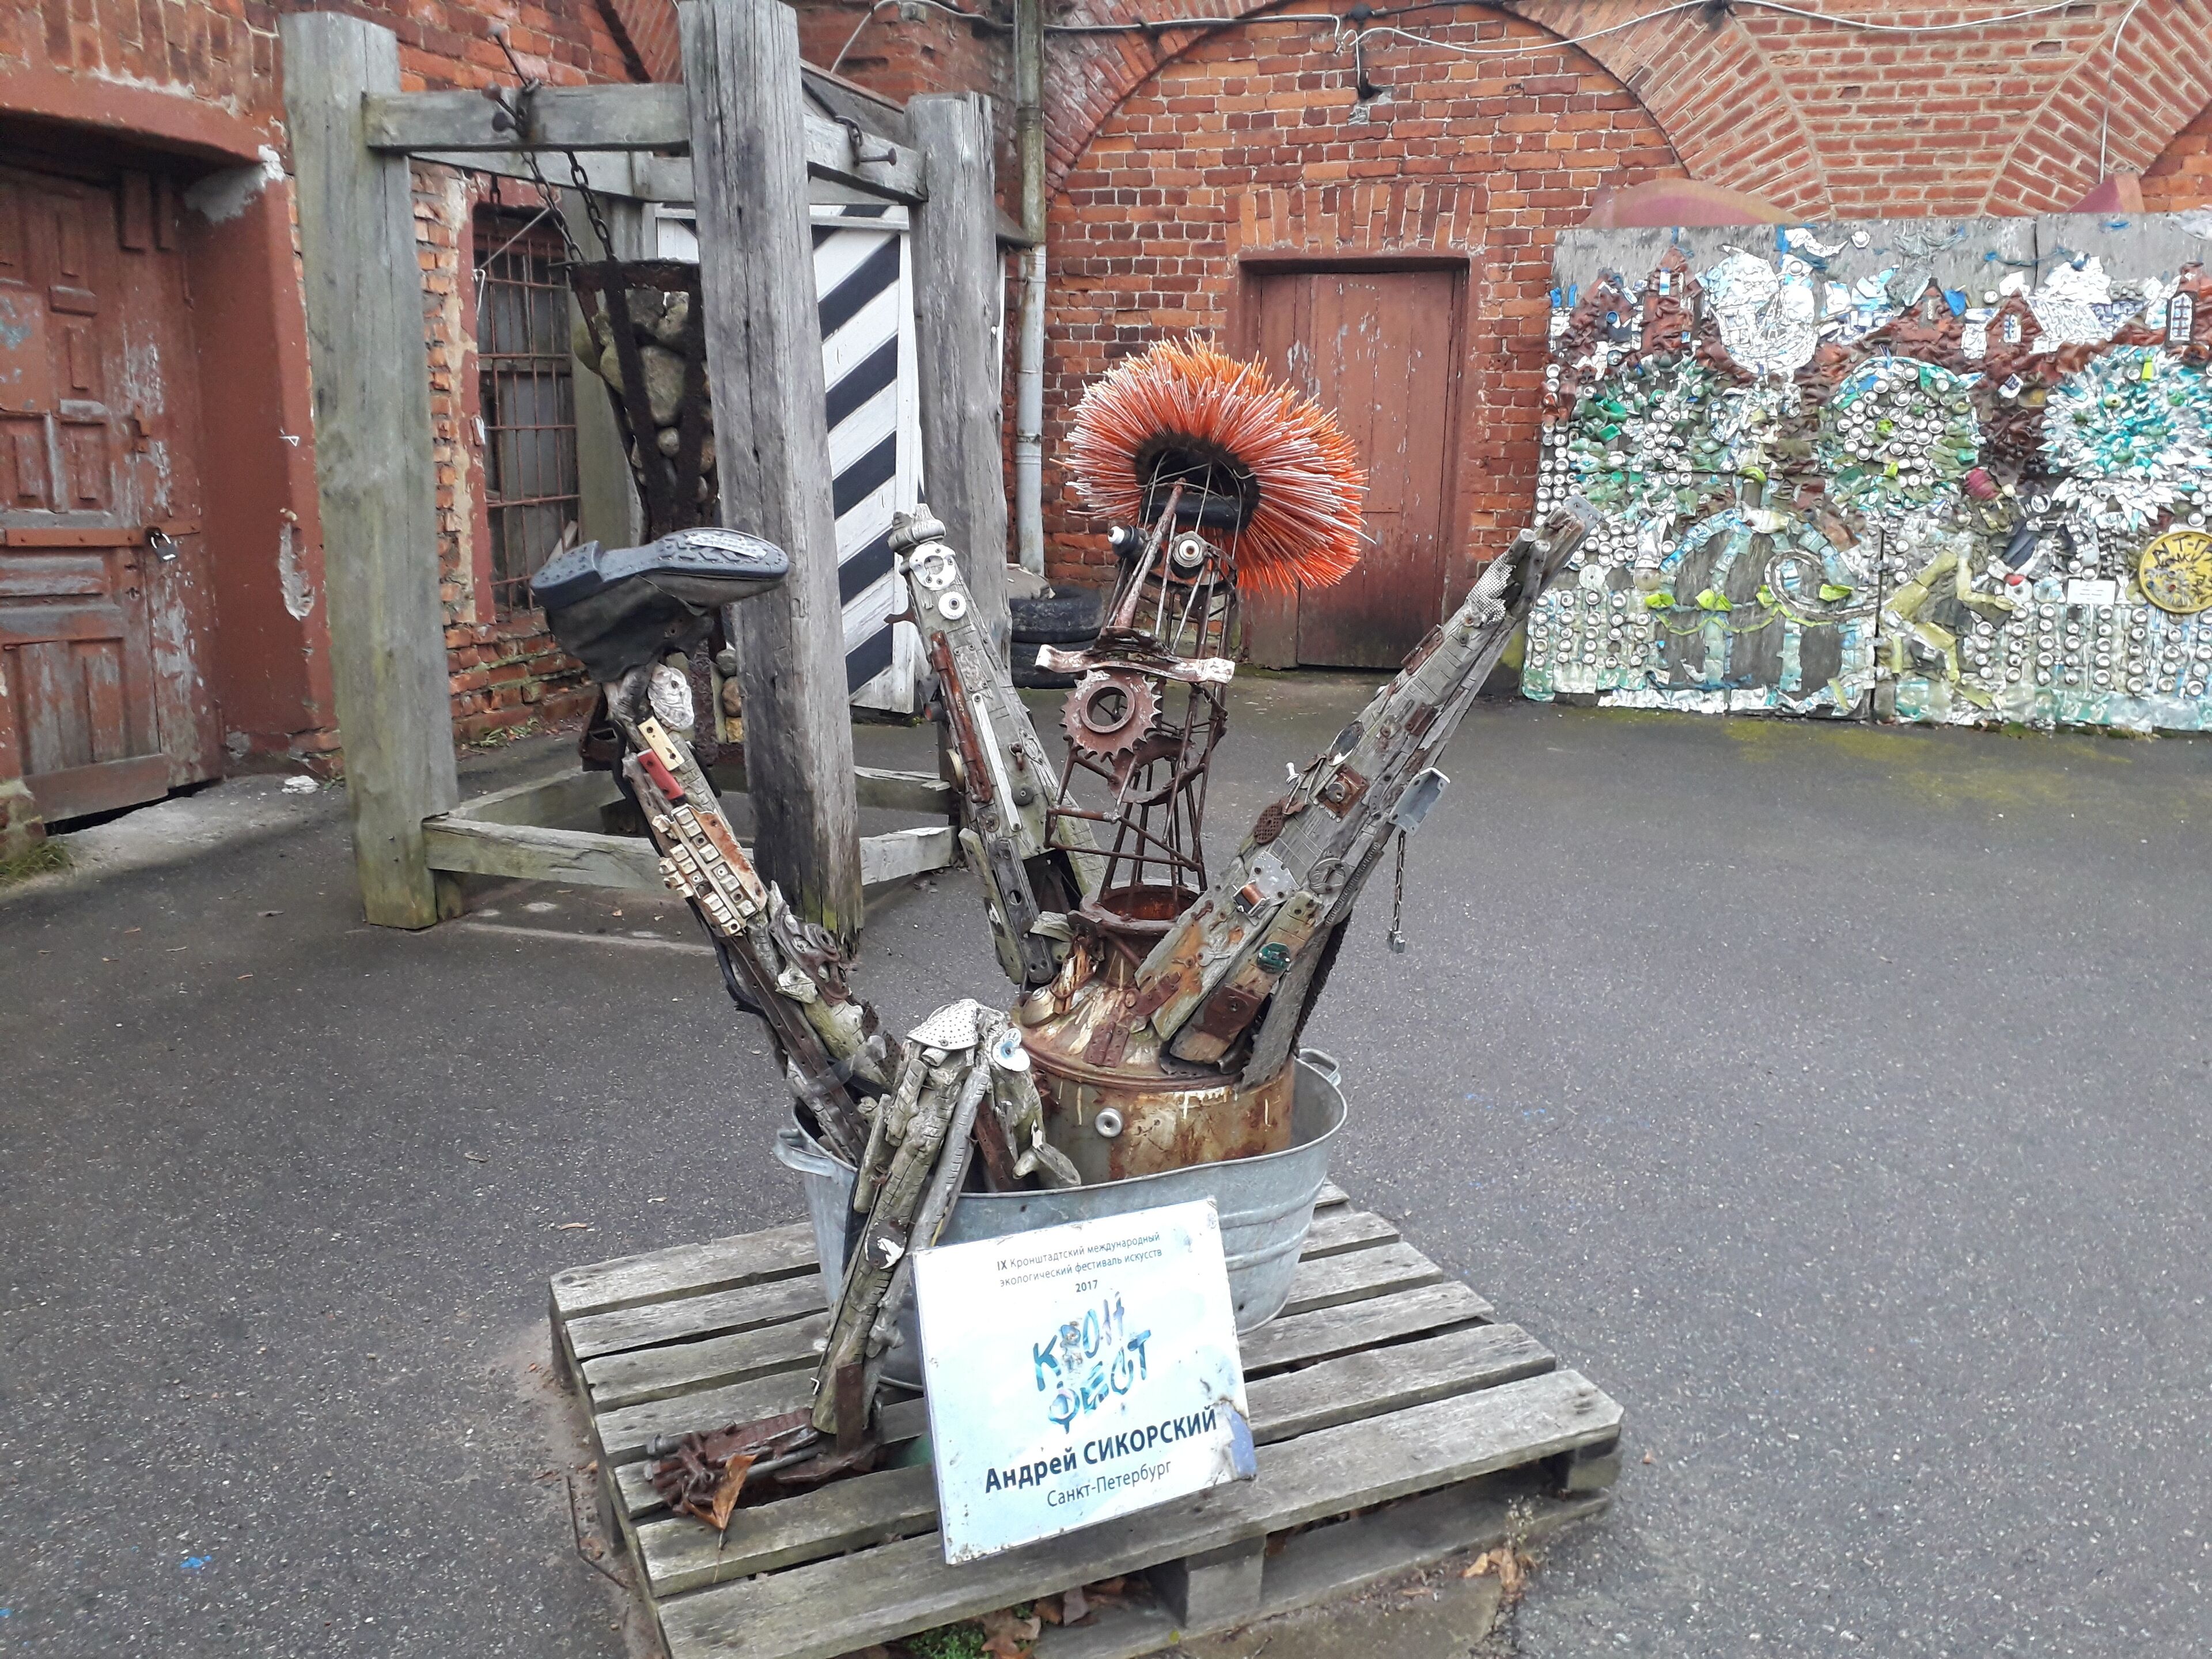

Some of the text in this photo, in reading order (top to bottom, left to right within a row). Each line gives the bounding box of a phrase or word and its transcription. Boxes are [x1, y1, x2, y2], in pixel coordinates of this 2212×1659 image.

[997, 1232, 1160, 1271] IX Кронштадтский международный
[1000, 1248, 1162, 1287] экологический фестиваль искусств
[1075, 1279, 1099, 1293] 2017
[985, 1405, 1217, 1493] Андрей СИКОРСКИЙ
[1047, 1461, 1172, 1507] Санкт-Петербург
